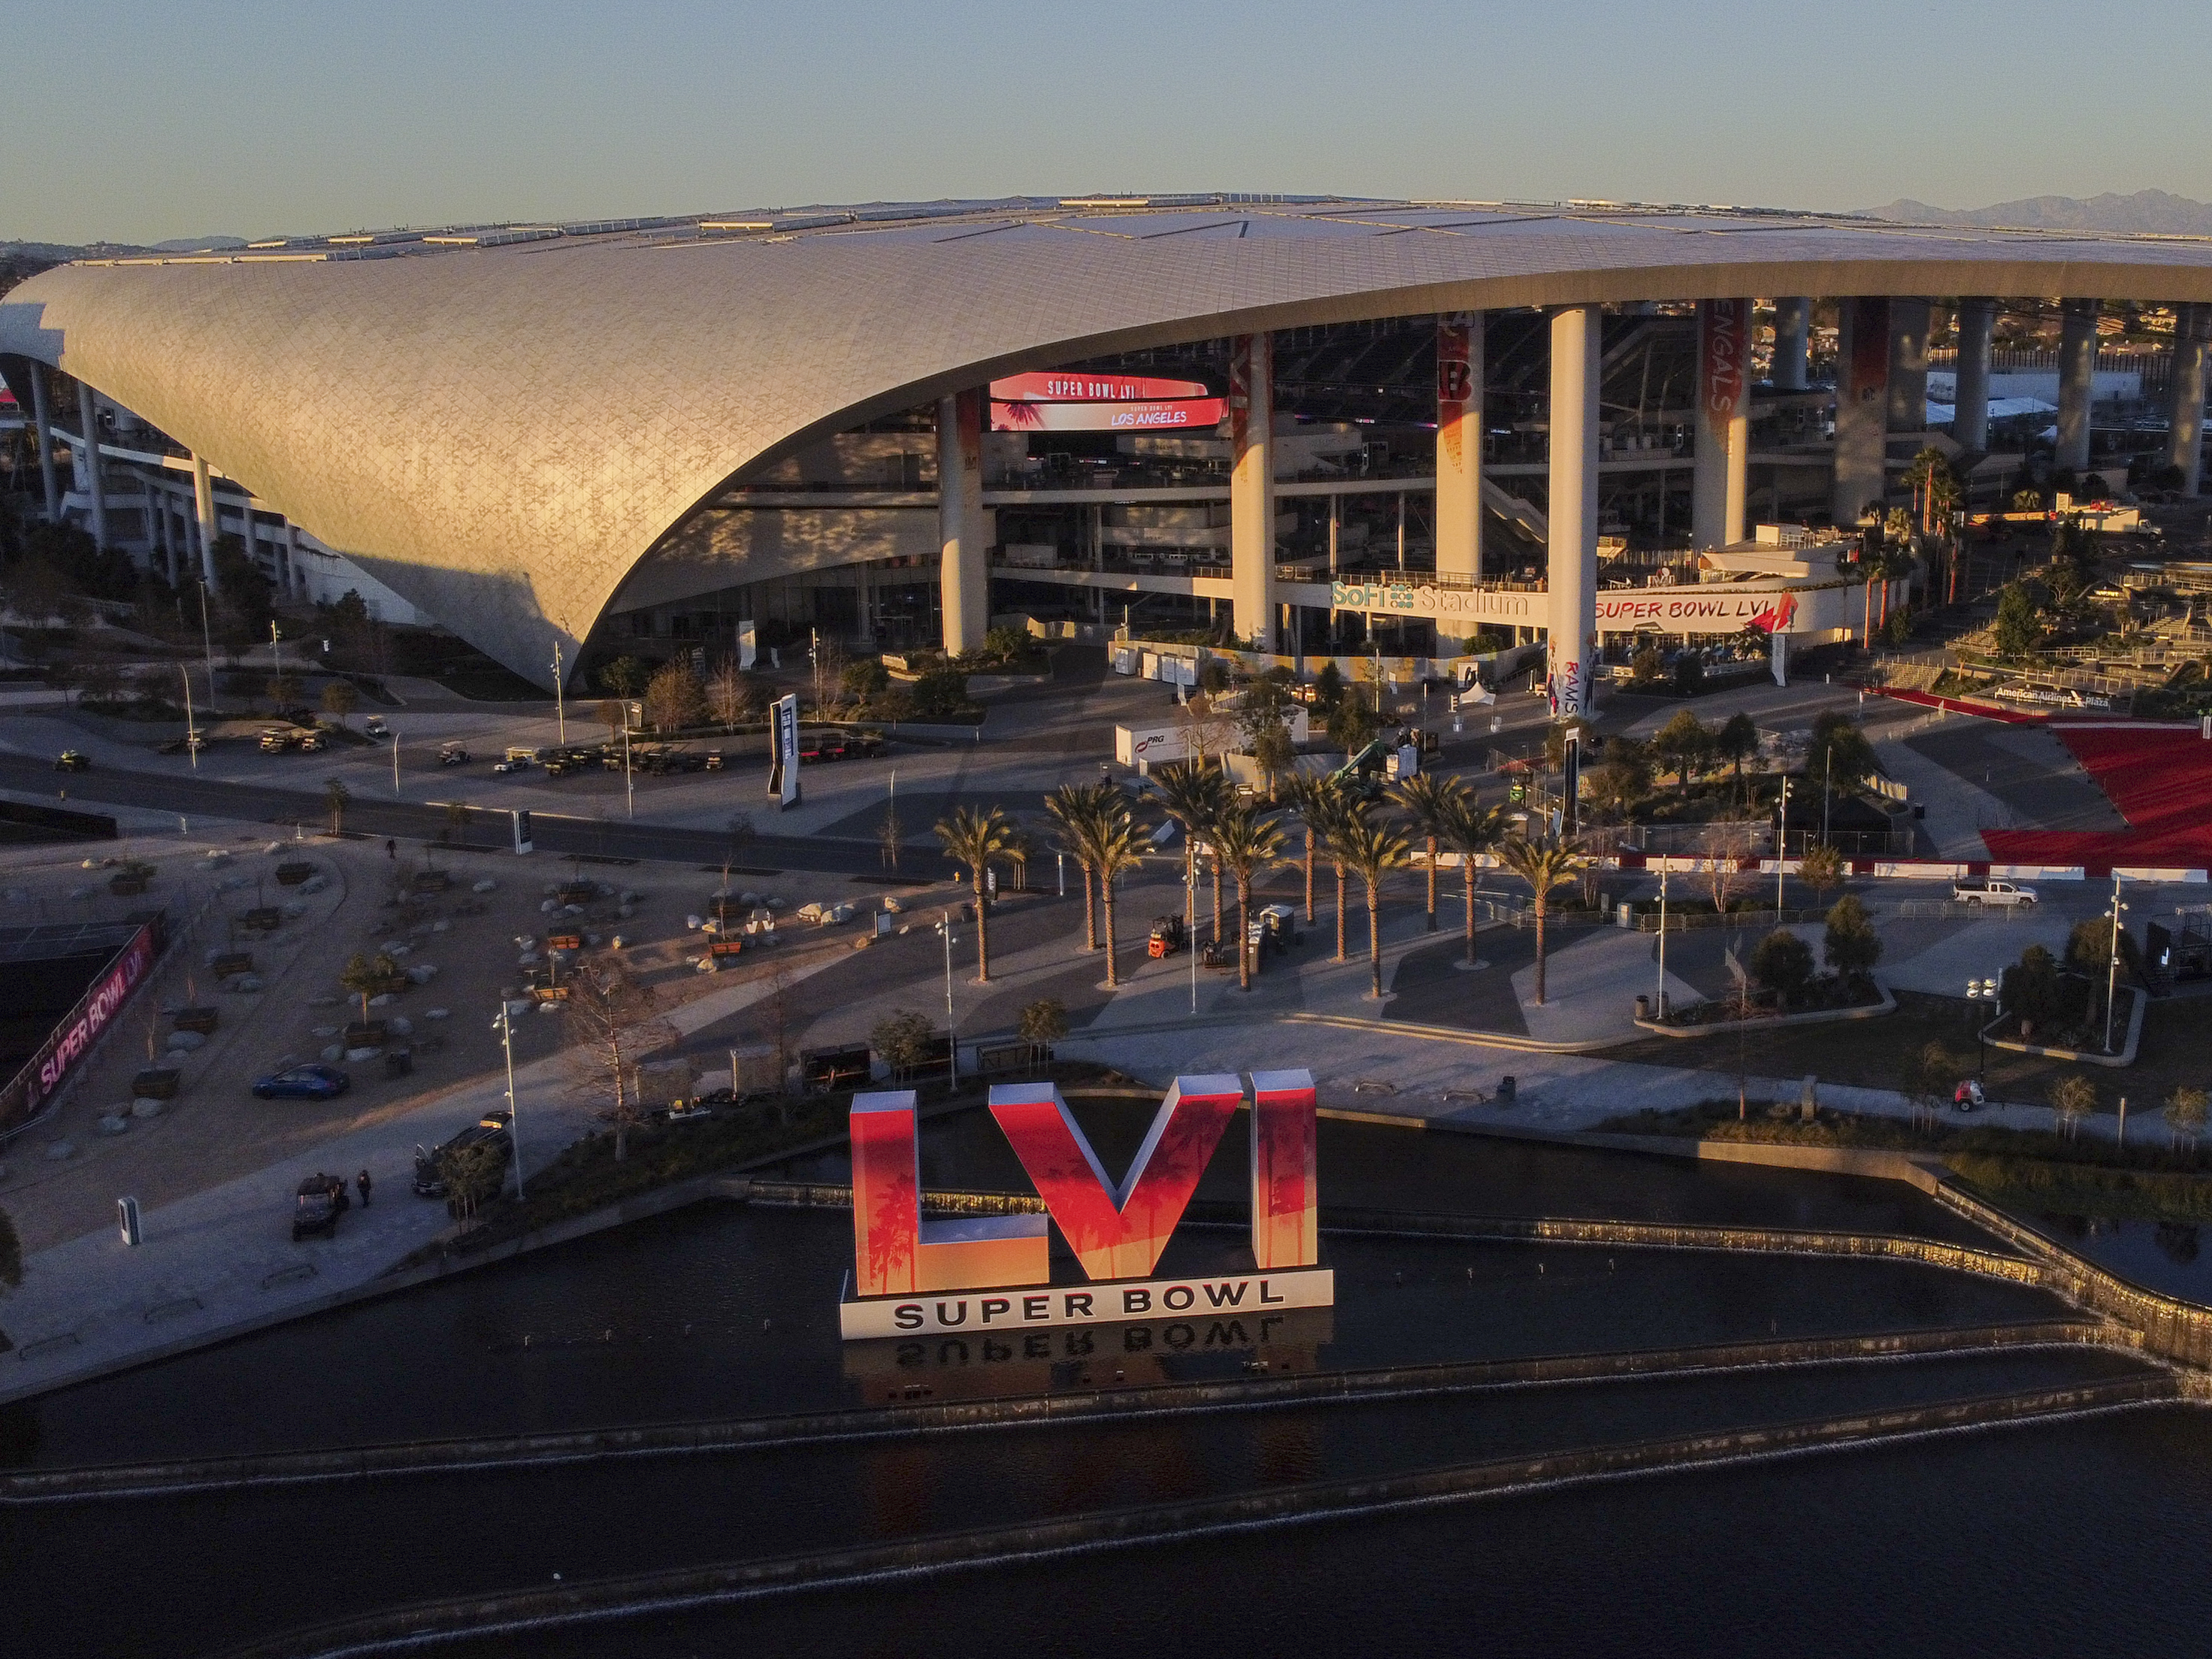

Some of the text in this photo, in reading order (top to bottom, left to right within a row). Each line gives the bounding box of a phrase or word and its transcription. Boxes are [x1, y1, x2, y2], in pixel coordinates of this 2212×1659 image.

[1711, 298, 1735, 411] ENGALS
[1047, 380, 1135, 399] SUPER BOWL LVI
[1111, 411, 1188, 426] LOS ANGELES
[1330, 580, 1529, 616] SoFi Stadium
[1596, 600, 1769, 619] SUPER BOWL LVI
[1565, 661, 1579, 714] RAMS
[1996, 687, 2109, 707] American Airlines Plaza
[1147, 735, 1165, 743] PRG
[41, 1017, 89, 1094] SUPER
[89, 972, 126, 1034] BOWL
[849, 1070, 1317, 1295] LVI
[894, 1280, 1286, 1329] SUPER BOWL
